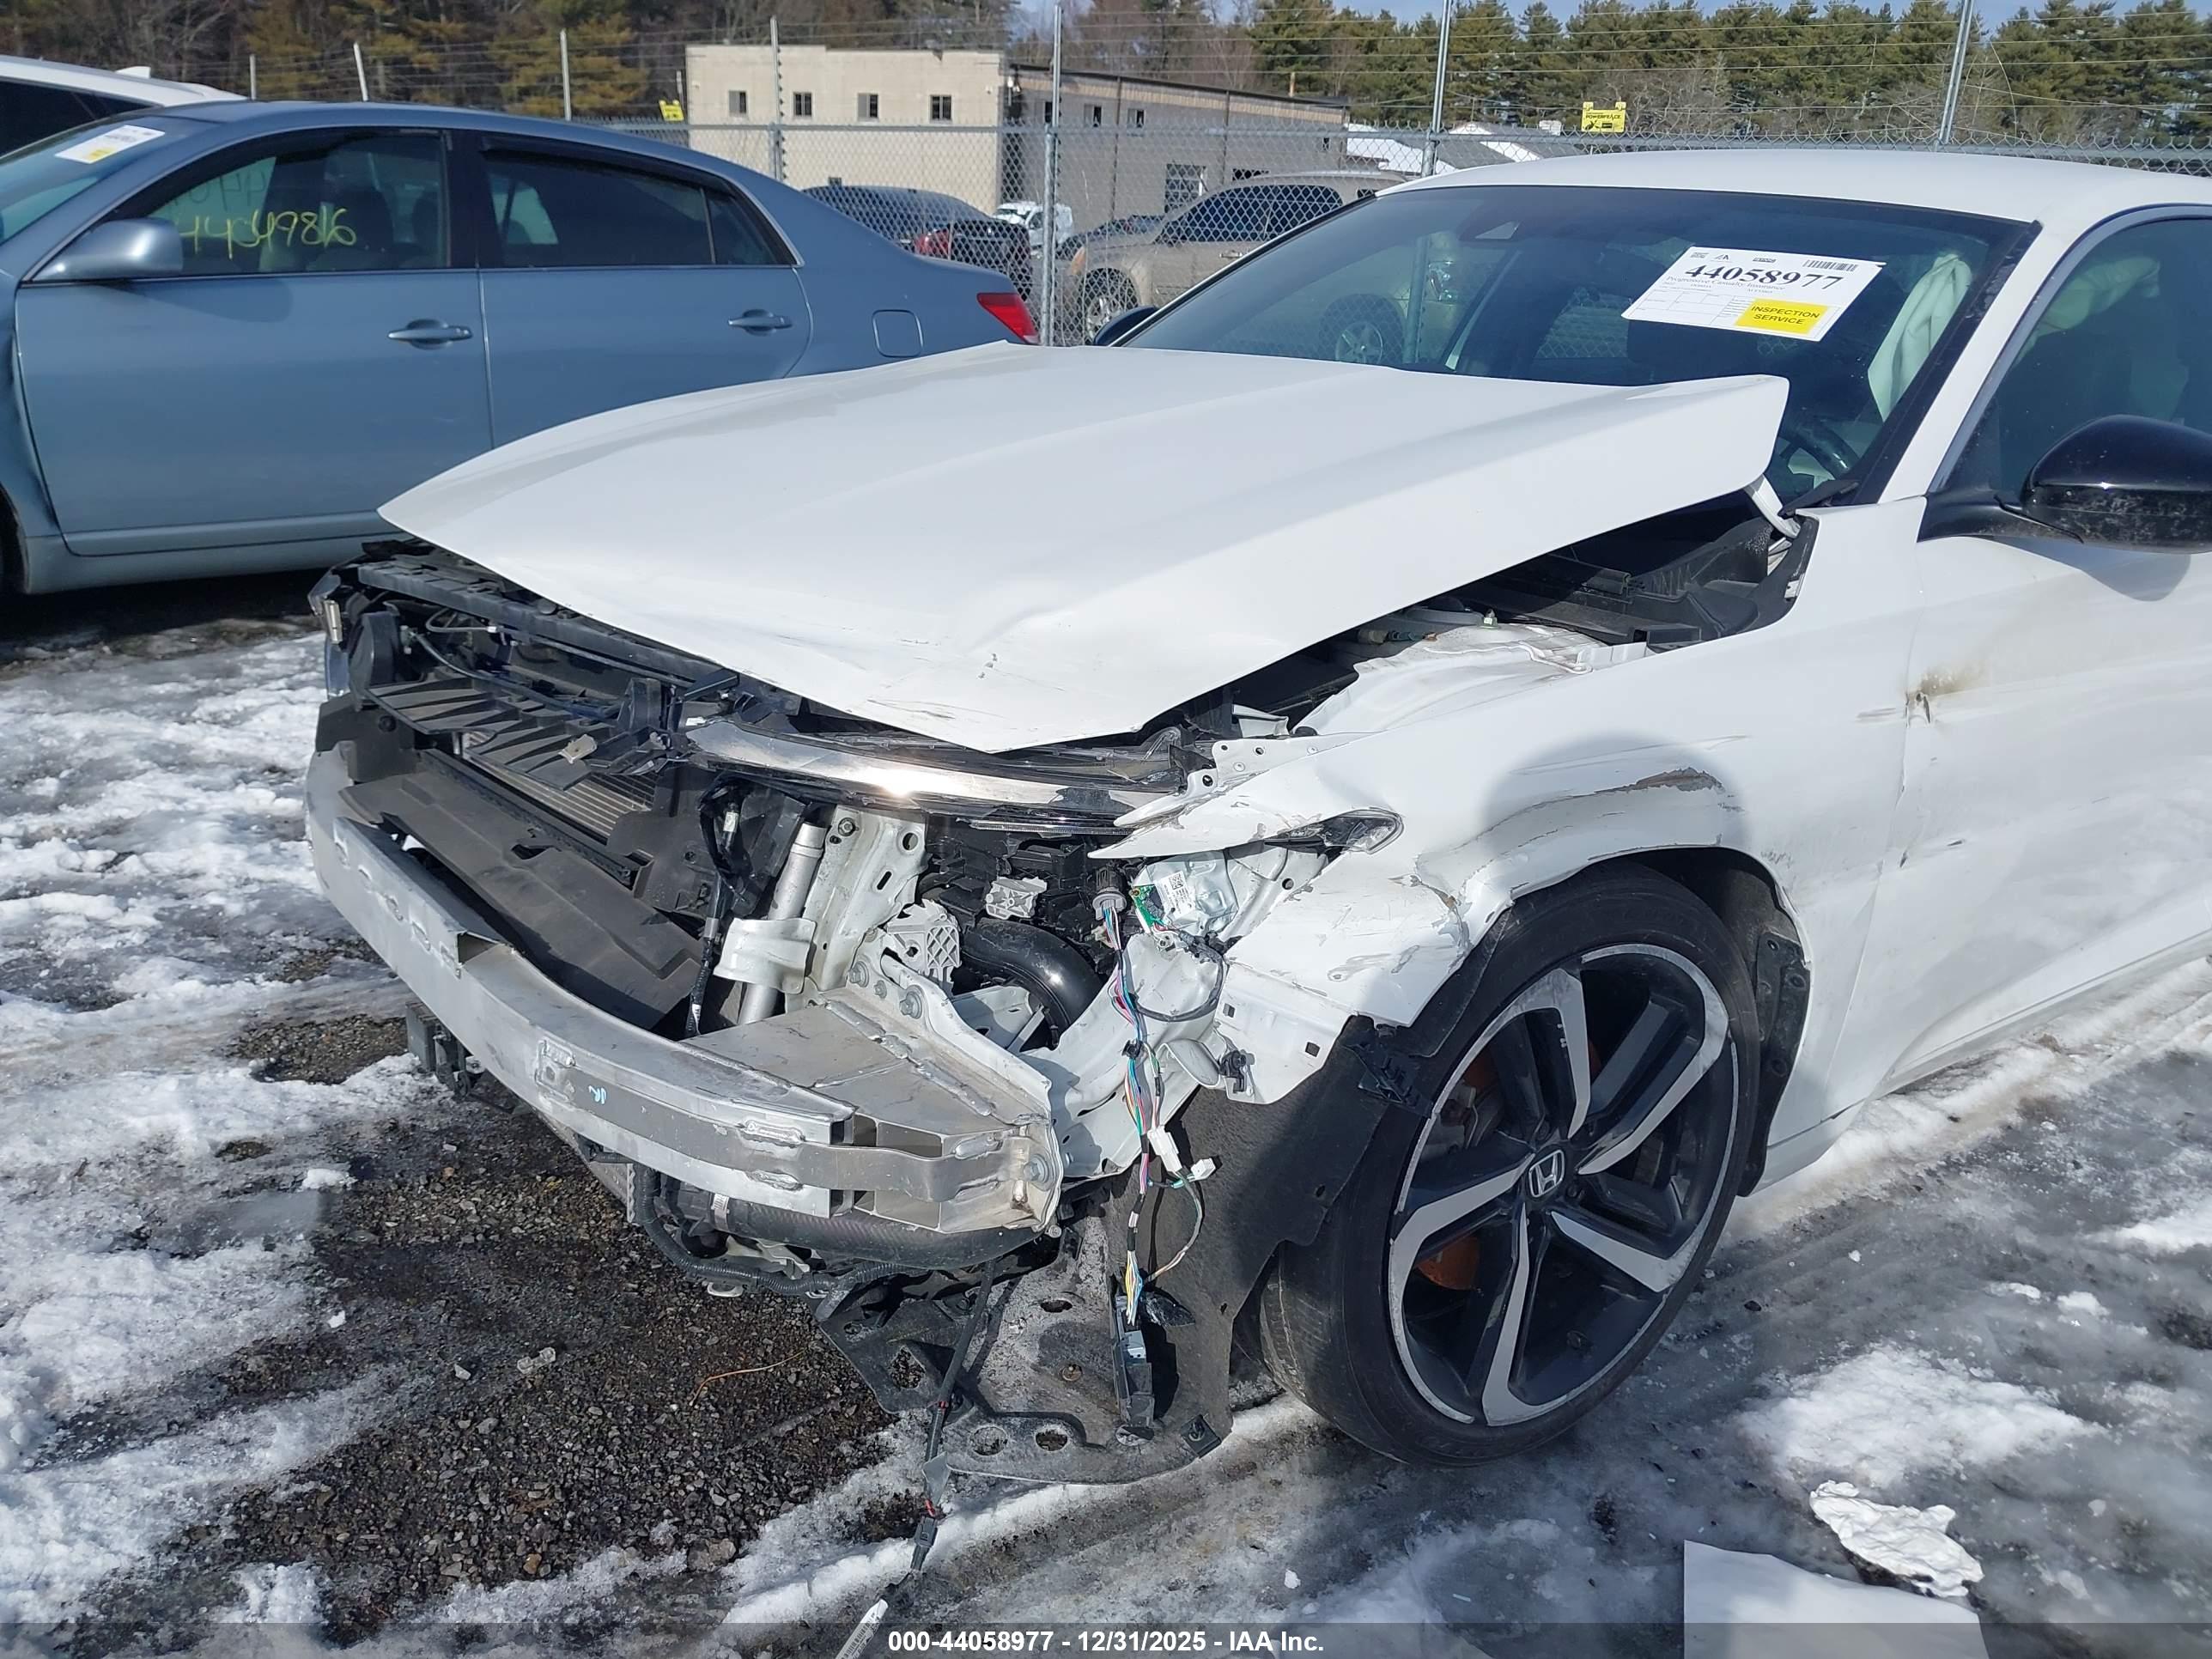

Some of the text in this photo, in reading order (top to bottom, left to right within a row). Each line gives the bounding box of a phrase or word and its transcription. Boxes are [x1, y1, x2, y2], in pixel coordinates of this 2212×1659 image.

[1685, 264, 1844, 289] 44058977
[1751, 306, 1820, 319] INSPECTION
[1753, 313, 1806, 325] SERVICE
